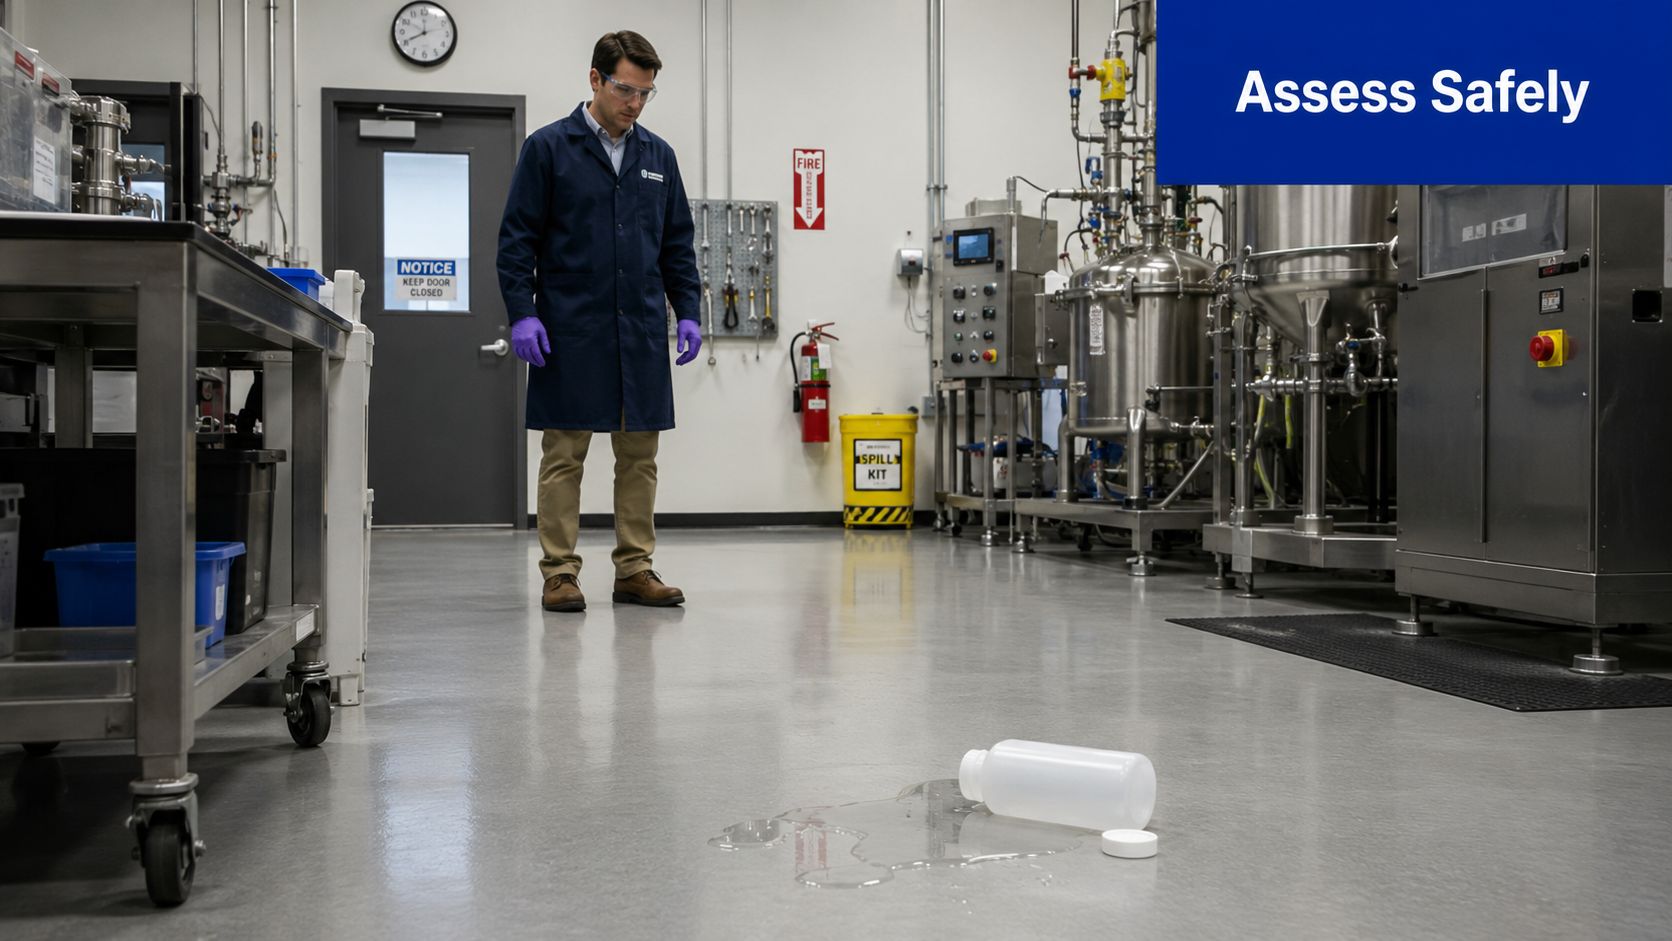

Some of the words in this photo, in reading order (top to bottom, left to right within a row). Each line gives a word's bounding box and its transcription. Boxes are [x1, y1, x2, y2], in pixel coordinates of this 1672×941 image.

[797, 157, 821, 170] FIRE
[400, 261, 453, 275] NOTICE
[402, 277, 424, 287] KEEP
[426, 278, 450, 287] DOOR
[410, 288, 443, 297] CLOSED
[861, 453, 893, 465] SPILL
[868, 468, 887, 480] KIT
